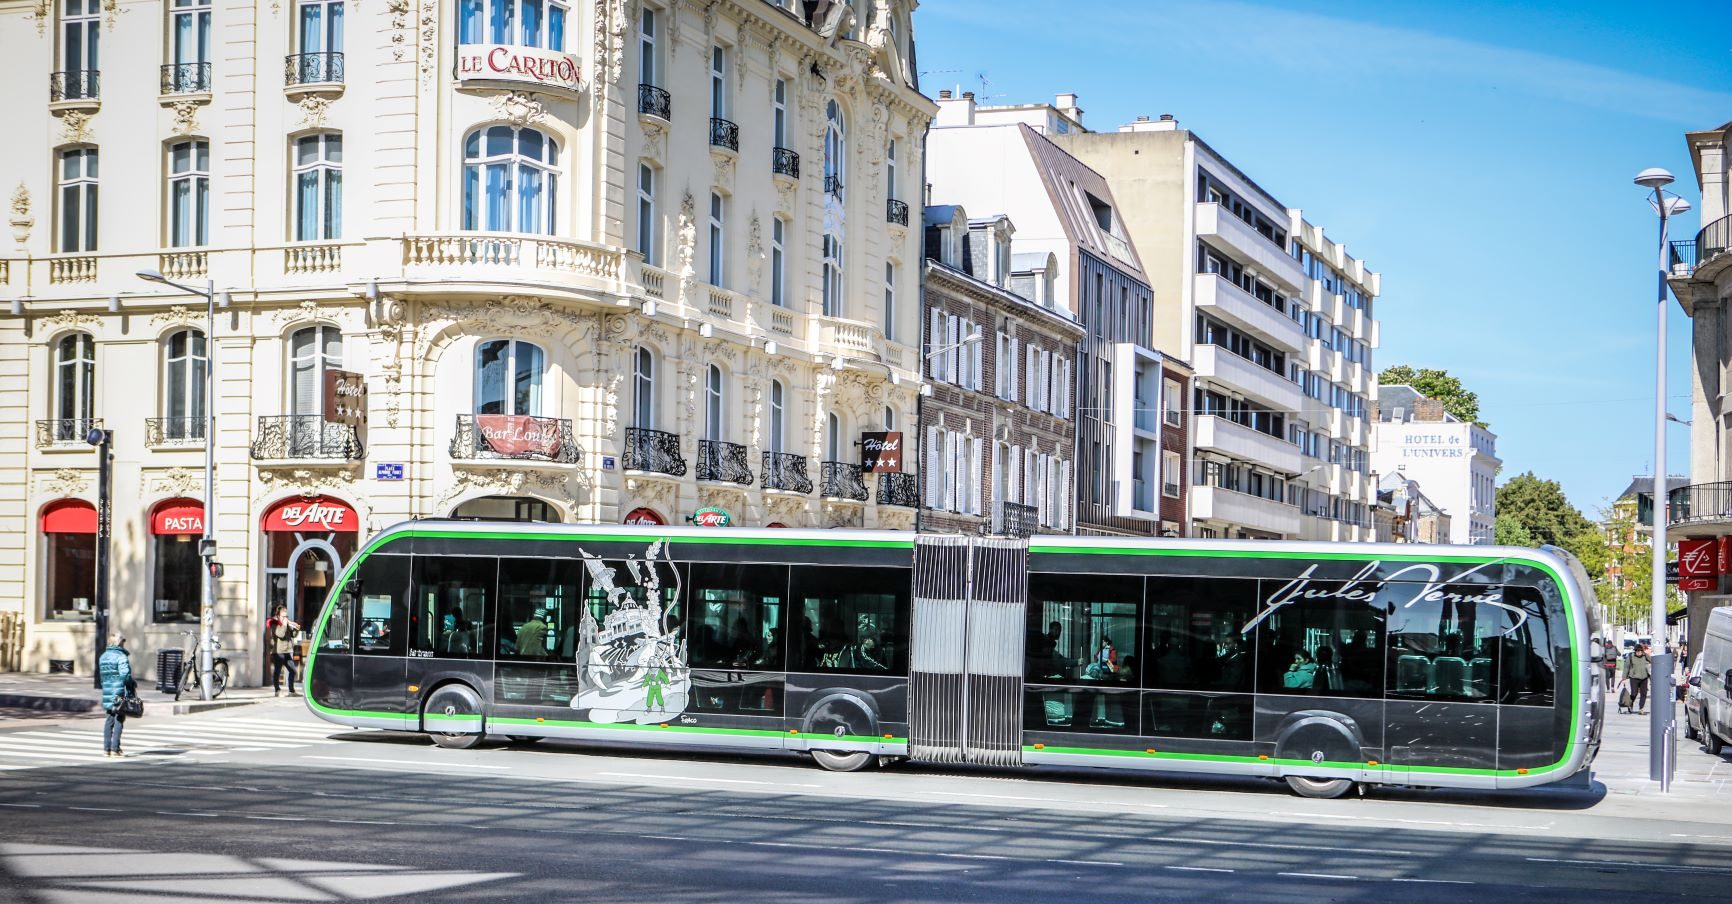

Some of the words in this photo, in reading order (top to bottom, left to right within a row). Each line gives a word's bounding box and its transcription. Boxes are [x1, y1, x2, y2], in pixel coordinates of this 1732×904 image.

[461, 56, 483, 73] LE
[335, 378, 363, 397] Hôtel
[482, 425, 509, 440] Bar
[1405, 435, 1444, 444] HOTEL
[1448, 435, 1460, 444] de
[863, 438, 898, 451] Hôtel
[1403, 448, 1463, 458] L'UNIVERS
[164, 517, 202, 530] PASTA
[1241, 560, 1382, 633] Jules
[1376, 555, 1528, 634] Verne
